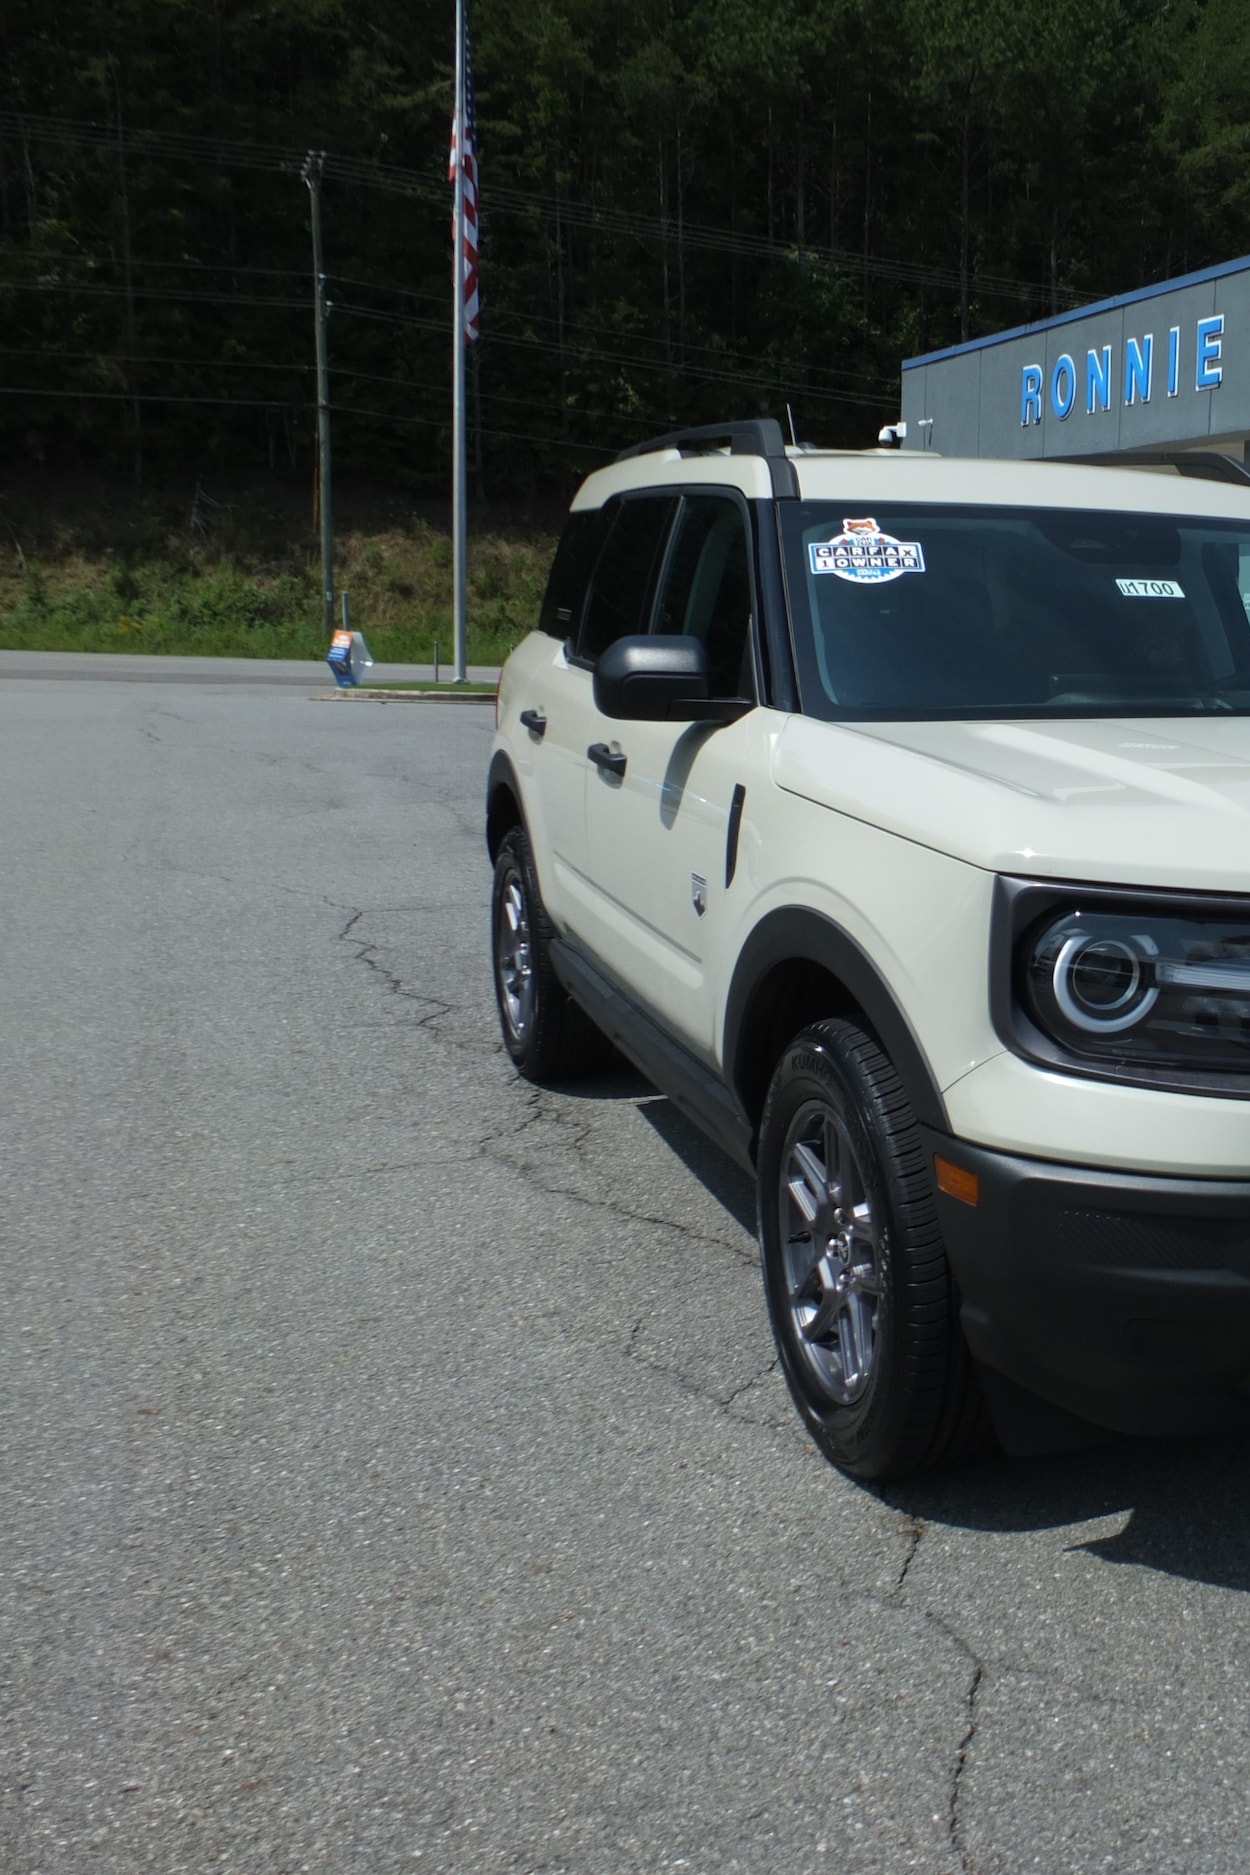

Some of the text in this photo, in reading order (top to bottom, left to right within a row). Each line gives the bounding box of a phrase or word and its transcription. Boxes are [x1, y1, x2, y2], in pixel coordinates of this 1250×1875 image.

[1019, 312, 1225, 427] RONNIE
[817, 546, 913, 557] CARFAX
[835, 557, 918, 567] OWNER
